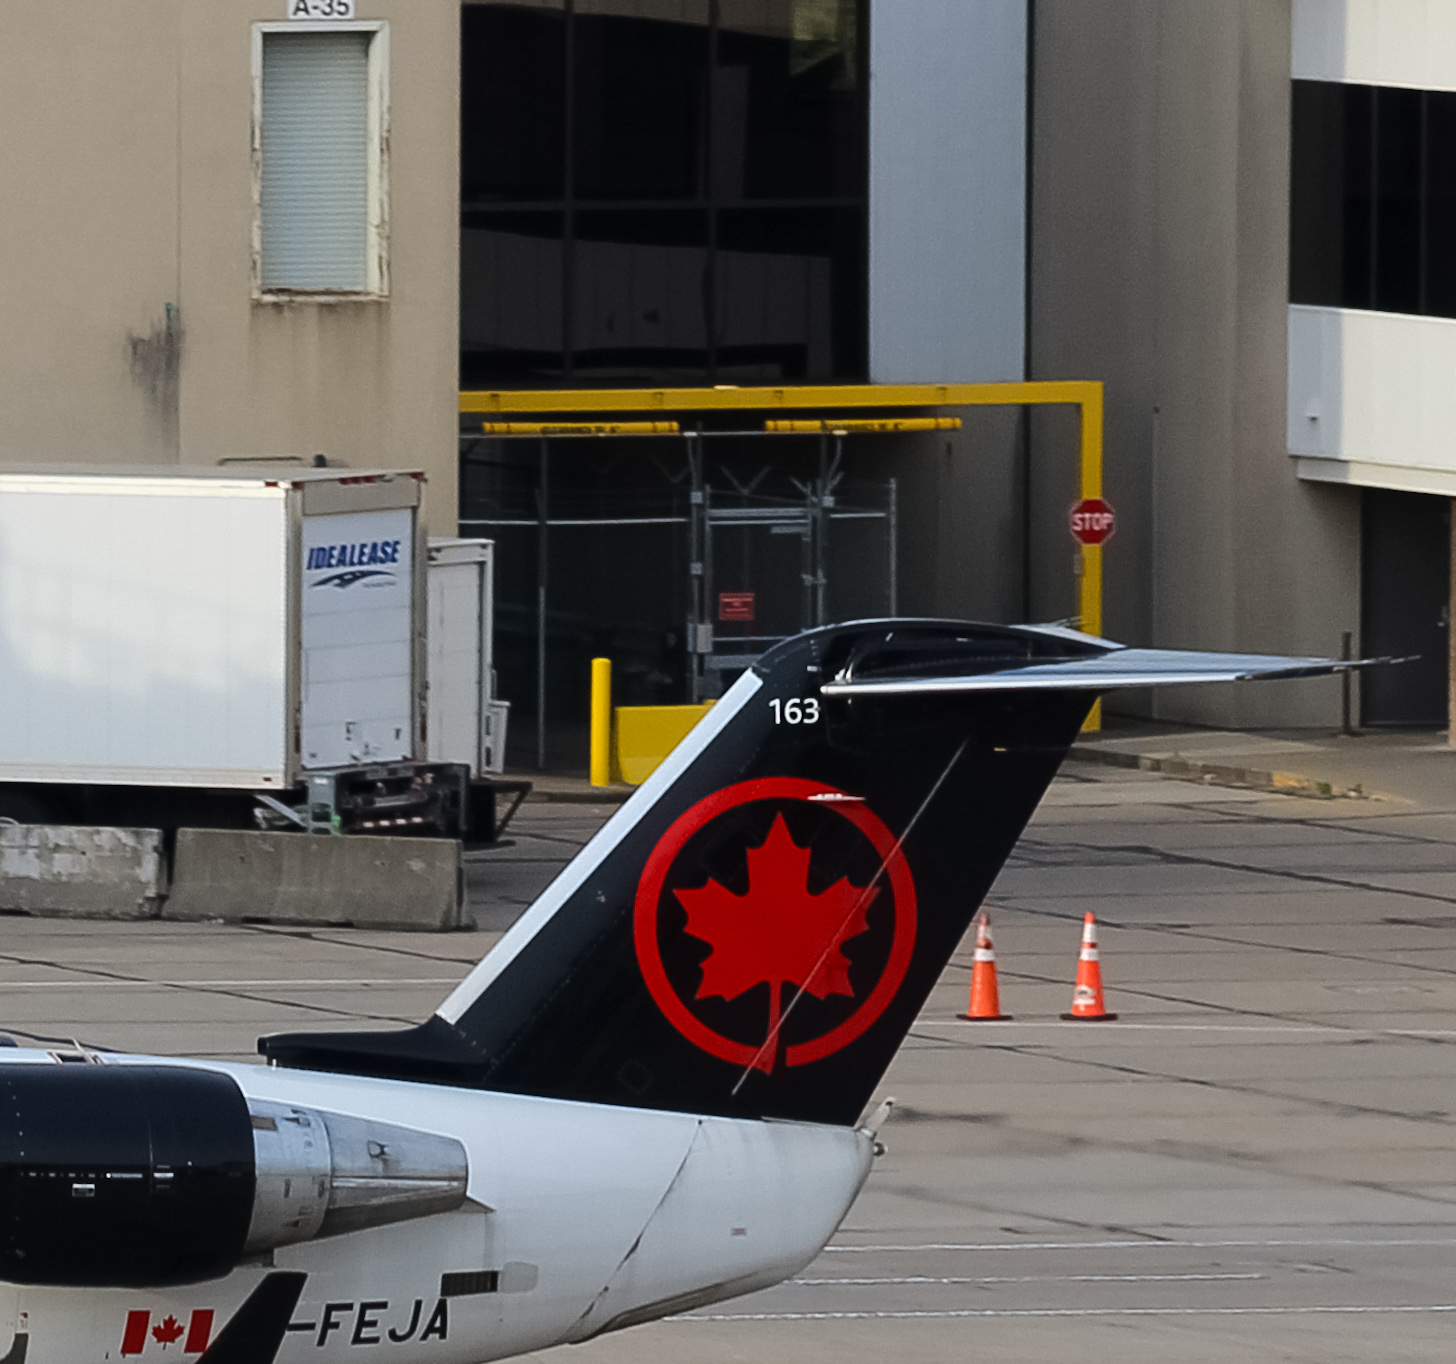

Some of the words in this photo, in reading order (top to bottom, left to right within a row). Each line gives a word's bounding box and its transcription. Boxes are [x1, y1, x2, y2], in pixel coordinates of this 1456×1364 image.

[293, 0, 349, 15] A-35
[1072, 513, 1114, 531] STOP
[307, 540, 401, 570] IDEALEASE
[768, 697, 819, 725] 163
